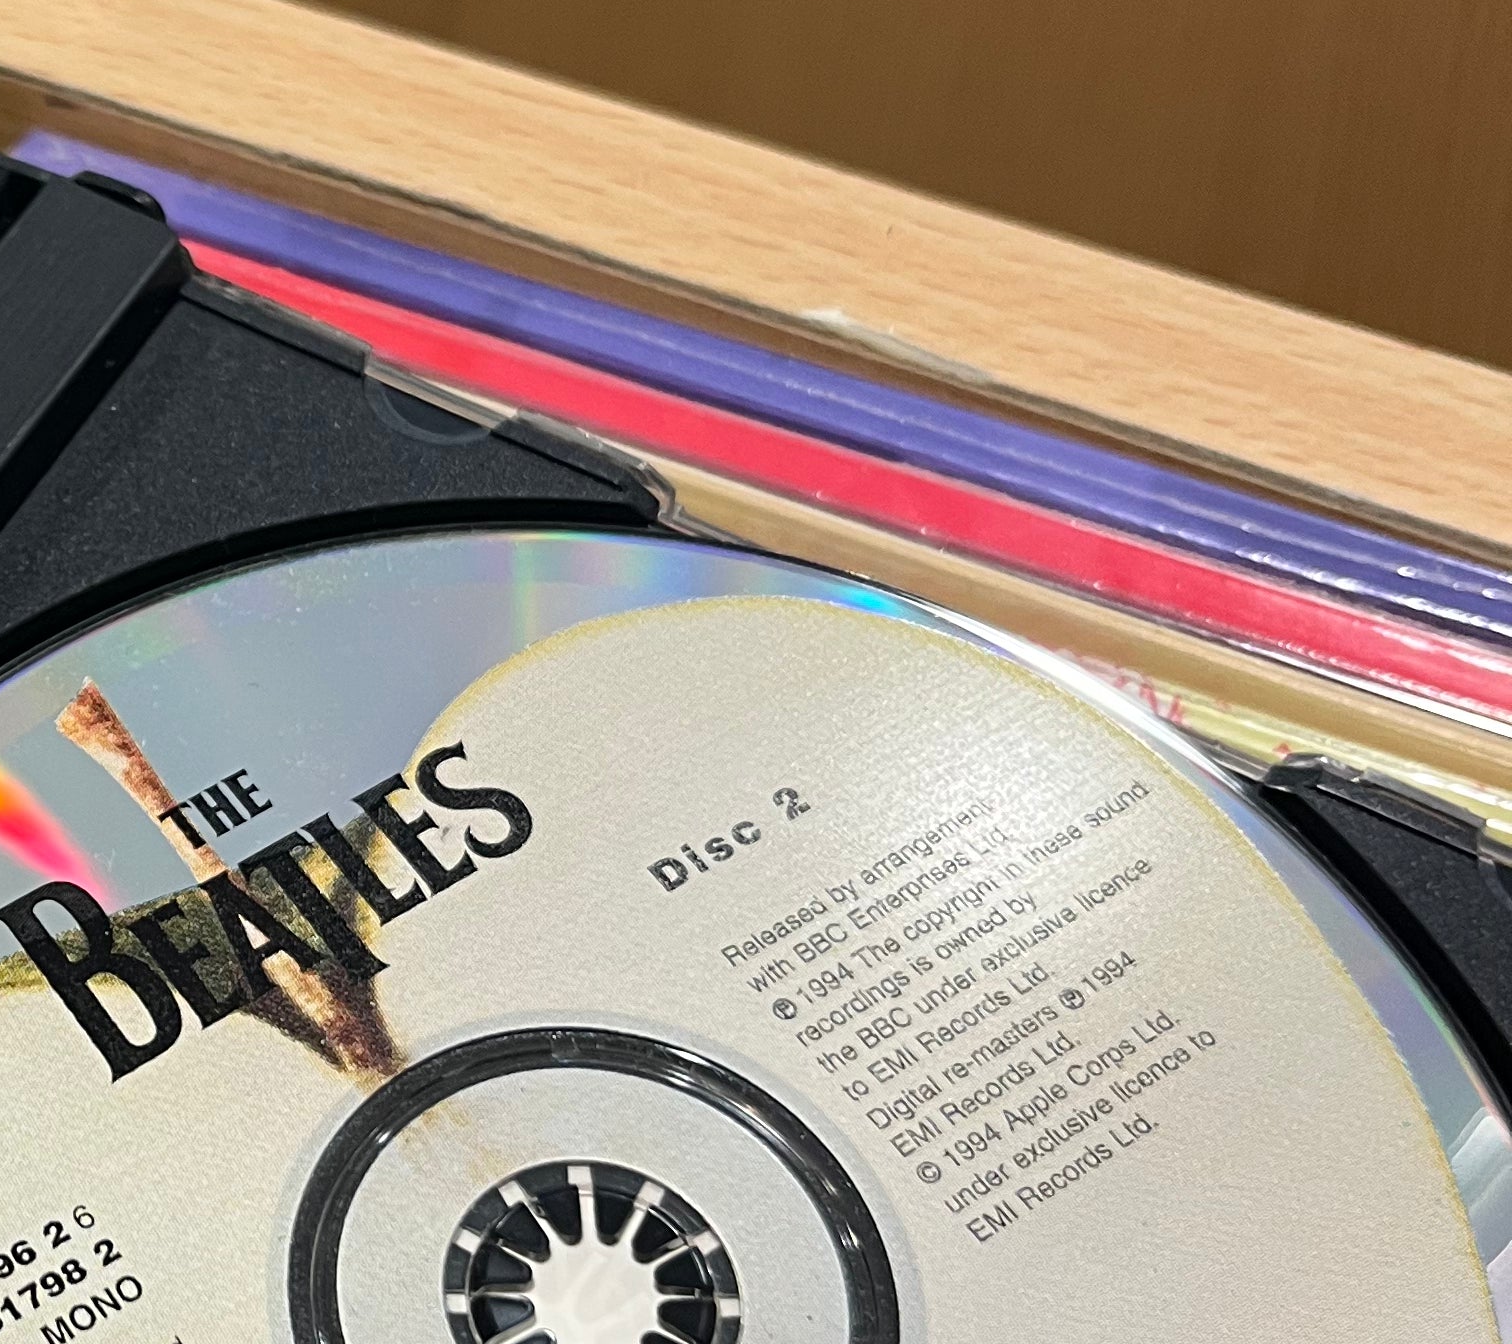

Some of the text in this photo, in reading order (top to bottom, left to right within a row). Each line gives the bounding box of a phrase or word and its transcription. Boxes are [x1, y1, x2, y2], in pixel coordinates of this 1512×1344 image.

[159, 768, 273, 850] THE
[647, 787, 812, 892] Disc 2
[720, 801, 997, 968] Released by arrangement
[746, 958, 797, 994] with
[792, 922, 850, 964] BBC
[846, 850, 973, 931] Enterprises
[796, 961, 855, 1005] 1994
[851, 936, 902, 969] The
[902, 875, 1001, 943] copyright
[997, 861, 1026, 882] in
[1083, 780, 1151, 829] sound
[795, 891, 1038, 1048] recordings is owned by
[816, 859, 1153, 1075] the BBC under exclusive licence
[841, 961, 1057, 1102] to EMI Records Ltd.
[865, 1074, 943, 1131] Digital
[941, 1005, 1060, 1085] re-masters
[1080, 951, 1137, 992] 1994
[889, 1030, 1082, 1158] EMI Records Ltd.
[943, 1122, 1003, 1167] 1994
[1002, 1083, 1069, 1133] Apple
[1065, 1039, 1138, 1087] Corps
[1131, 1009, 1181, 1045] Ltd.
[944, 1030, 1217, 1214] under exclusive licence to
[965, 1112, 1160, 1243] EMI Records Ltd.
[42, 1220, 72, 1249] 2
[72, 1204, 96, 1230] 6
[93, 1238, 122, 1267] 2
